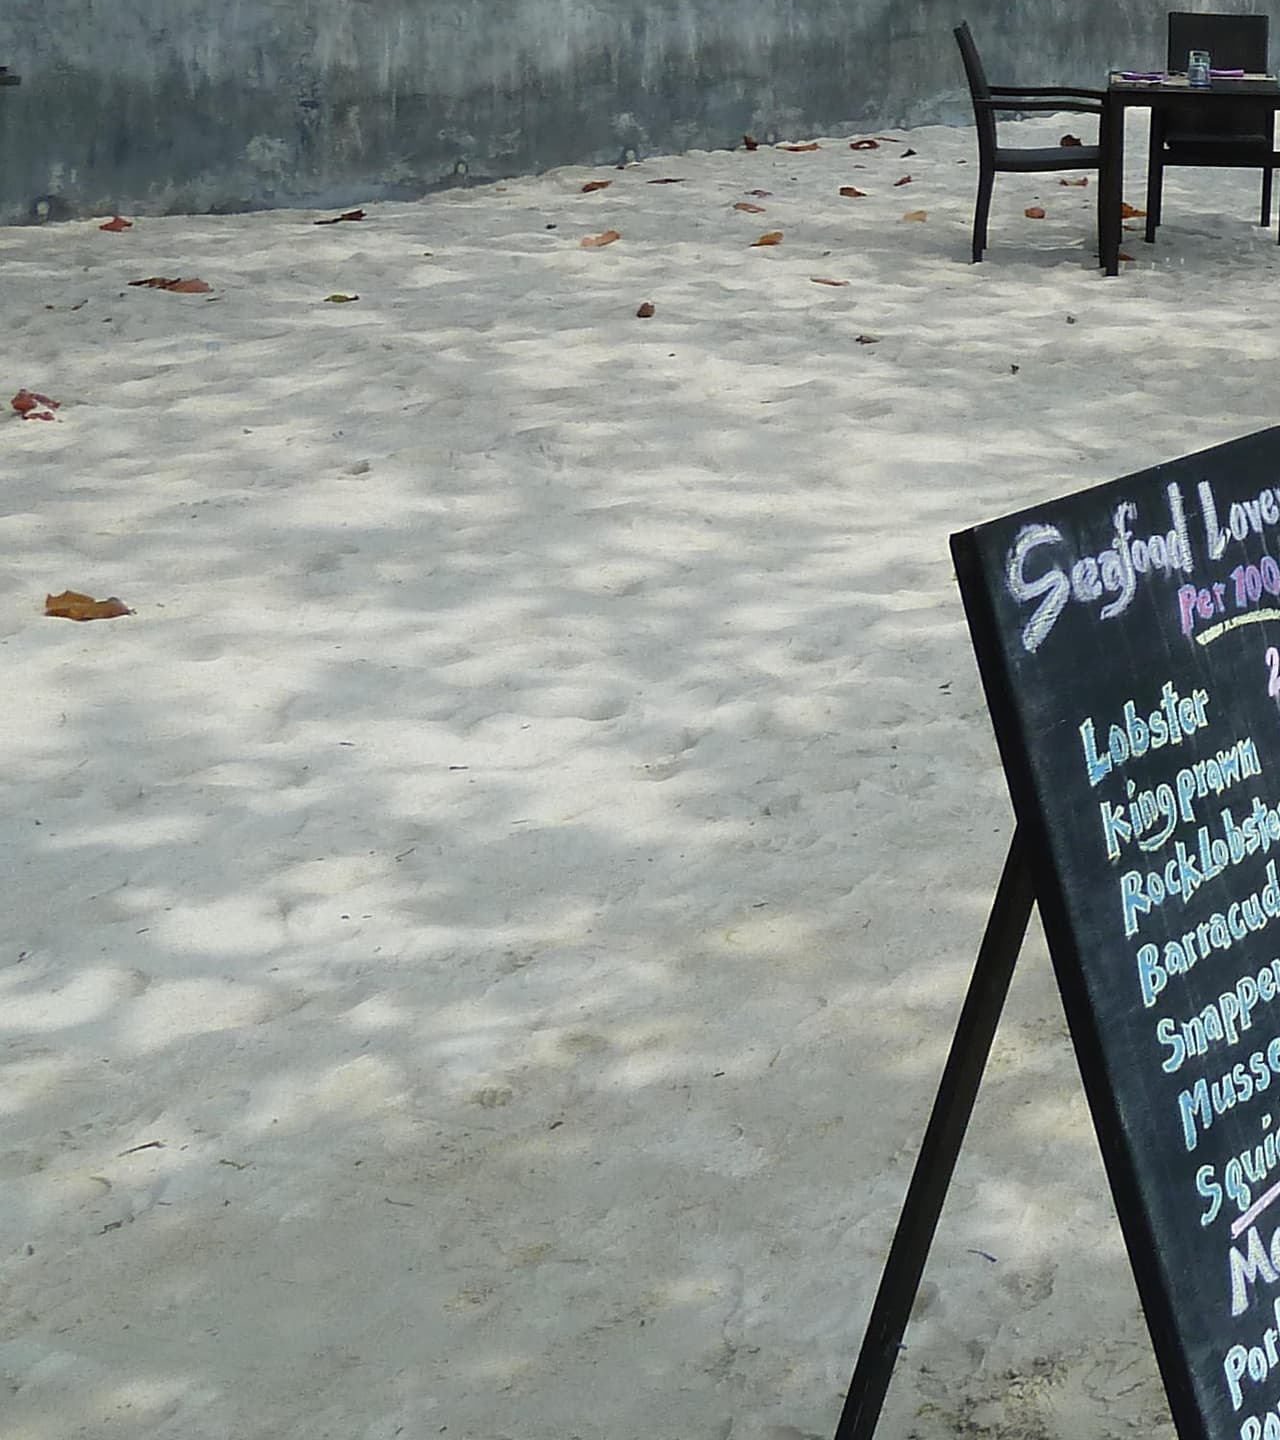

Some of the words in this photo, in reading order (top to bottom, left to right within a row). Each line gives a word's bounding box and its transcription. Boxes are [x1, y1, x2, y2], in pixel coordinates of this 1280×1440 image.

[1005, 481, 1194, 654] Seafood
[1230, 555, 1280, 608] 100
[1079, 680, 1210, 787] Lobster
